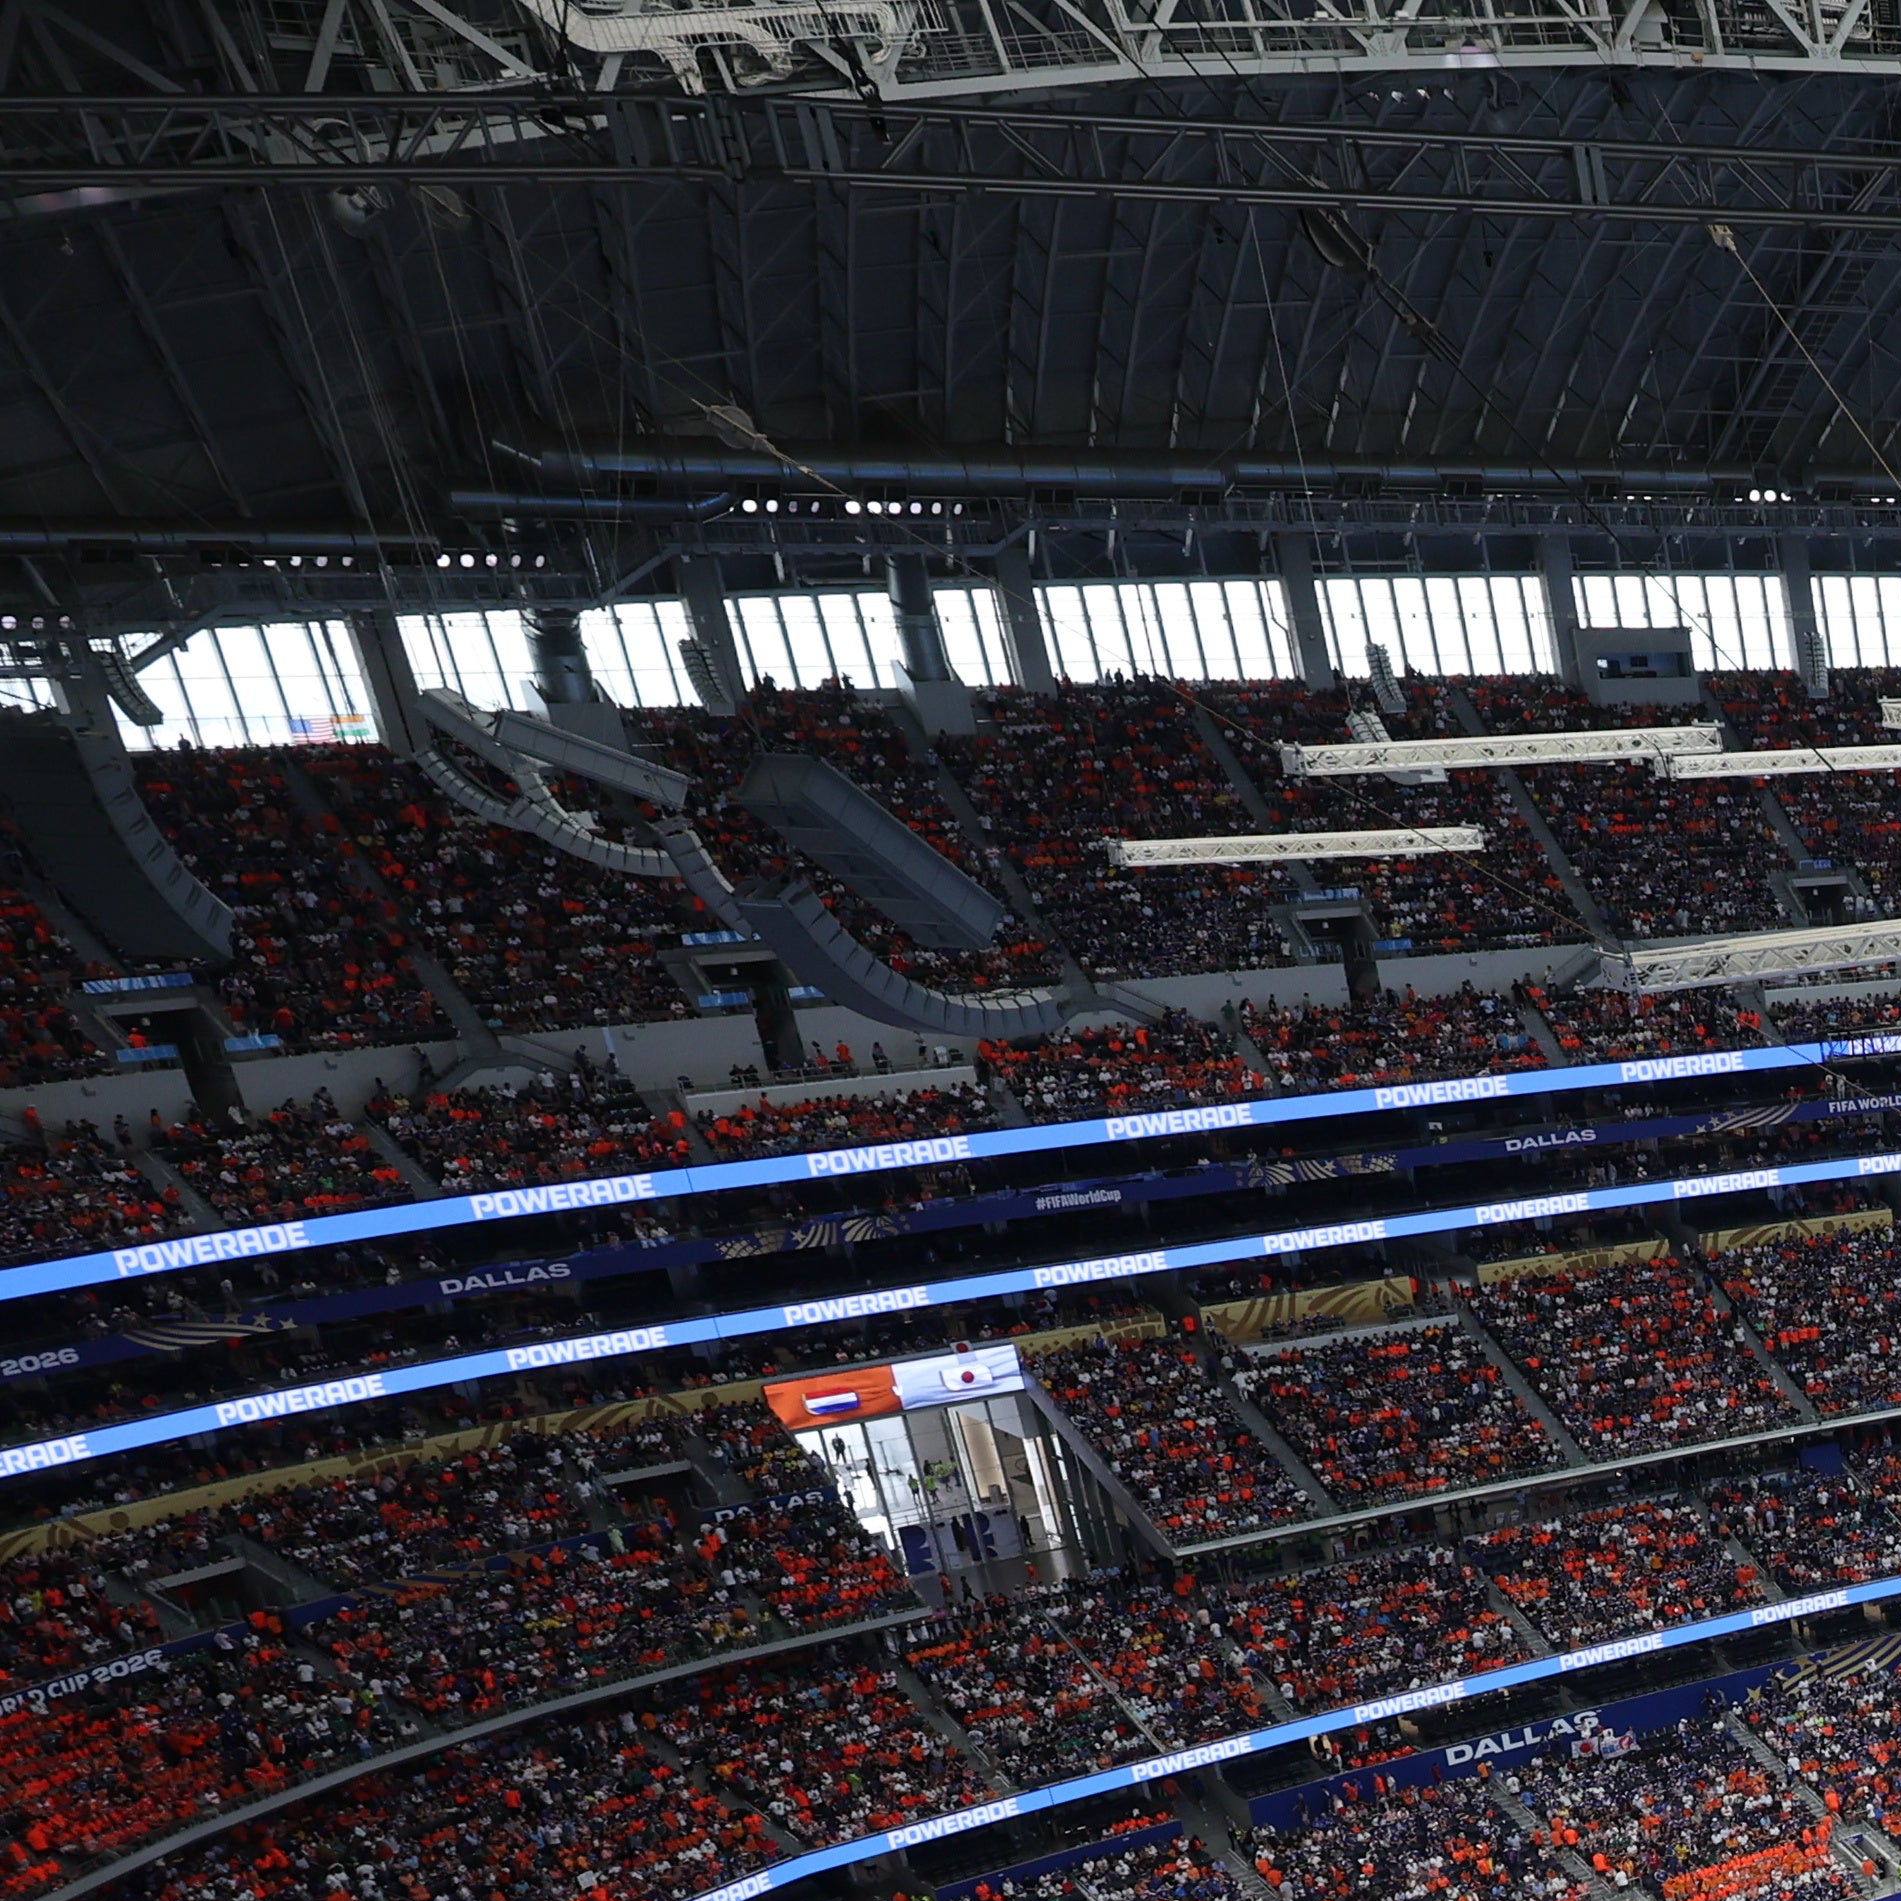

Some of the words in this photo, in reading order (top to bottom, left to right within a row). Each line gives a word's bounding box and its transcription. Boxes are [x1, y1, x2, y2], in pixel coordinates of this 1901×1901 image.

[1375, 1076, 1509, 1108] POWERADE
[1828, 1100, 1857, 1113] FIFA
[1504, 1129, 1597, 1151] DALLAS
[470, 1174, 655, 1218] POWERADE
[1035, 1189, 1121, 1211] #FIFAWorldCup
[1673, 1169, 1780, 1198] POWERADE
[1264, 1221, 1387, 1254] POWERADE
[440, 1263, 571, 1295] DALLAS
[1033, 1251, 1168, 1287] POWERADE
[783, 1286, 930, 1325] POWERADE
[0, 1347, 80, 1376] 2026
[216, 1374, 385, 1425] POWERADE
[714, 1491, 824, 1522] DALAS
[1752, 1590, 1848, 1625] POWERADE
[47, 1673, 90, 1699] CUP
[92, 1649, 163, 1684] 2026
[1354, 1681, 1467, 1722] POWERADE
[1445, 1711, 1600, 1766] DALLAS
[1131, 1736, 1253, 1781] POWERADE
[887, 1798, 1019, 1849] POWERADE
